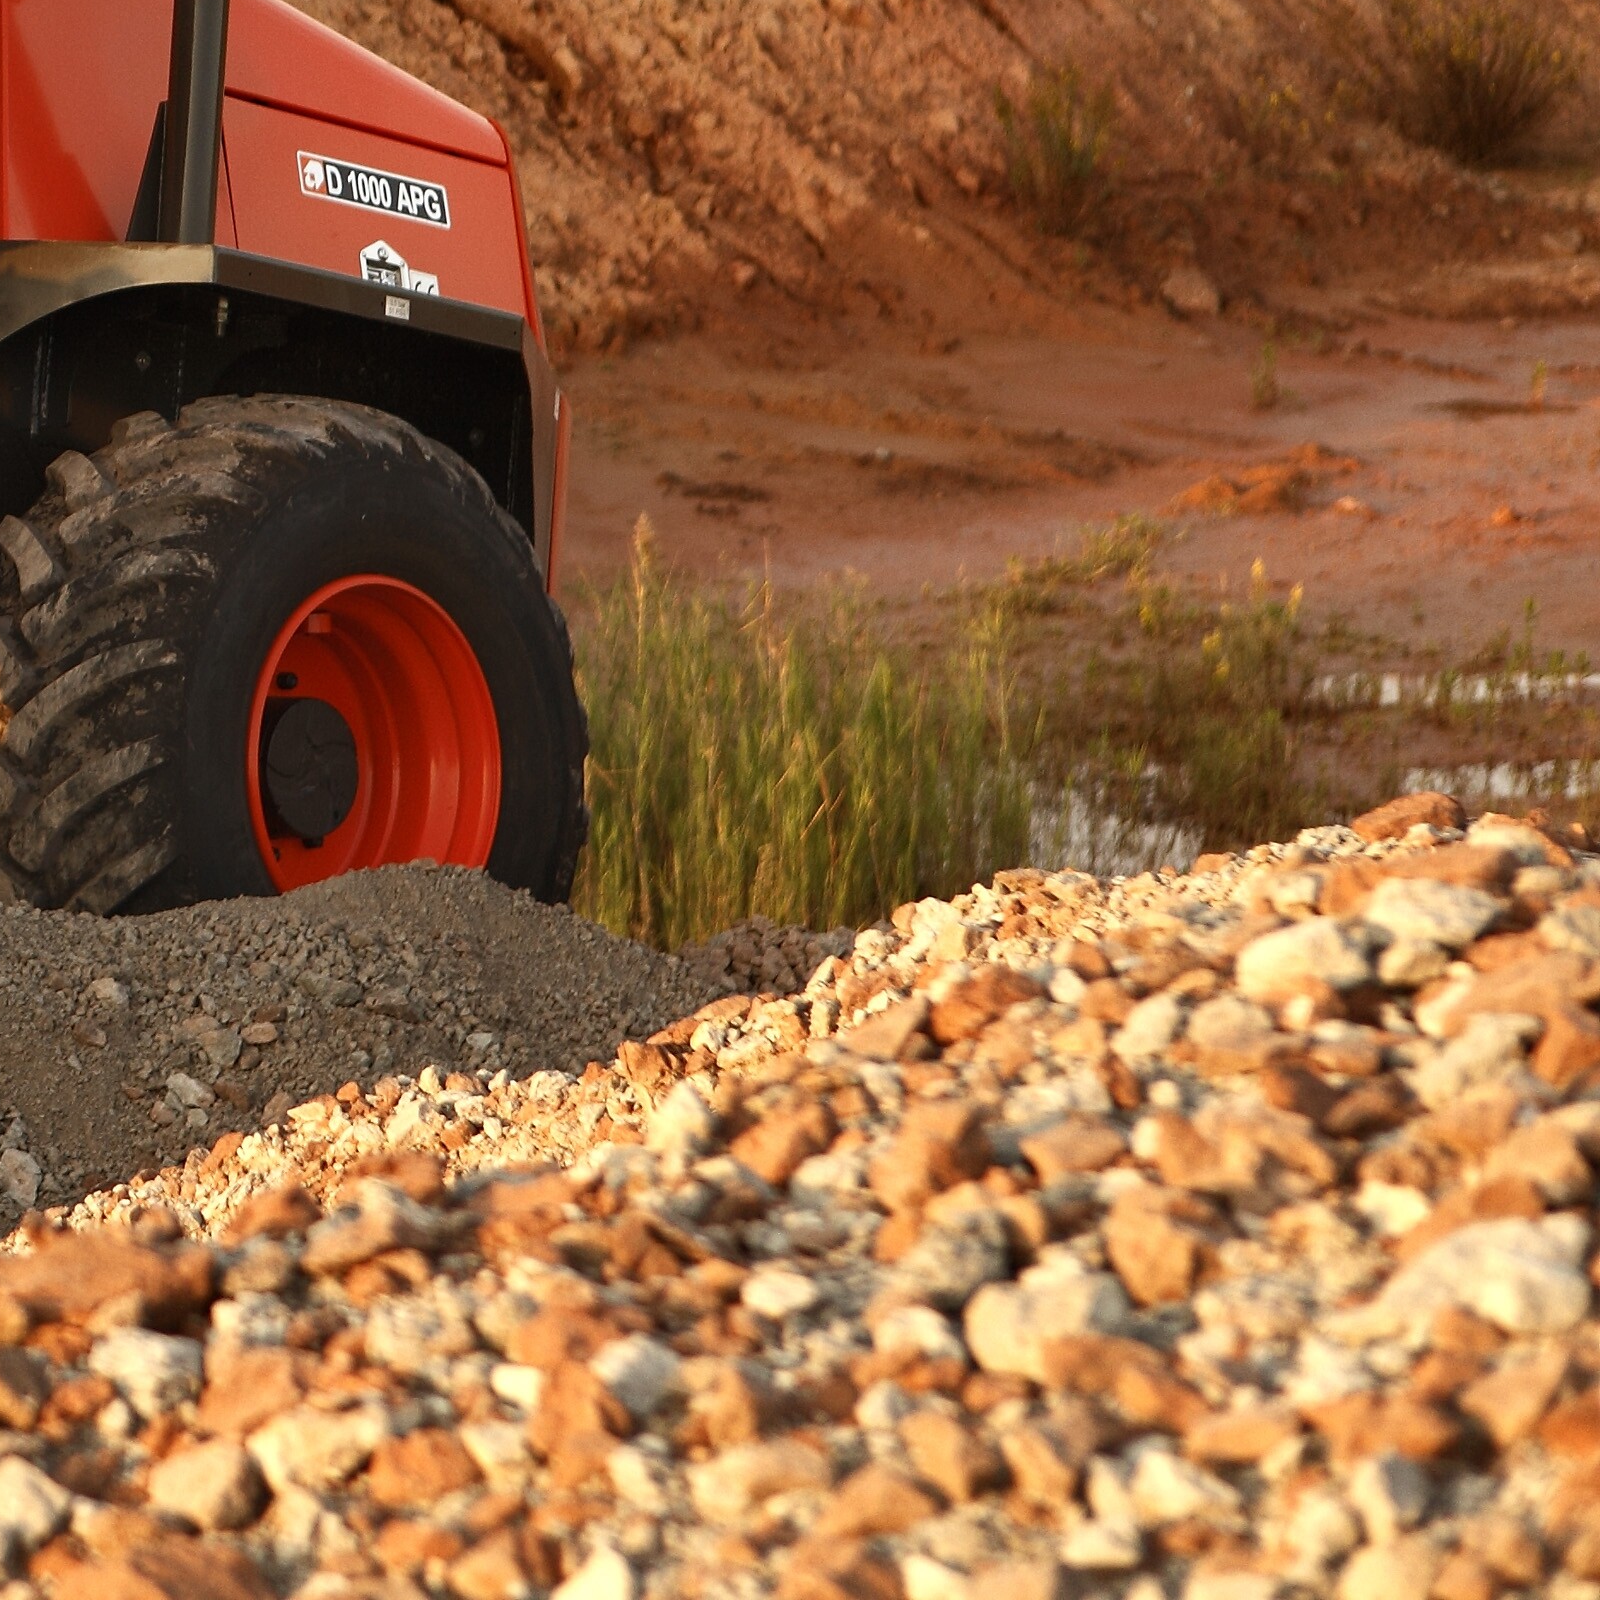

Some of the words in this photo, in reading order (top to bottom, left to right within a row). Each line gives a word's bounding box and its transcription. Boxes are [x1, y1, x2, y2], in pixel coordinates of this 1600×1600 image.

[325, 164, 343, 196] D
[348, 170, 391, 208] 1000
[398, 182, 441, 220] APG
